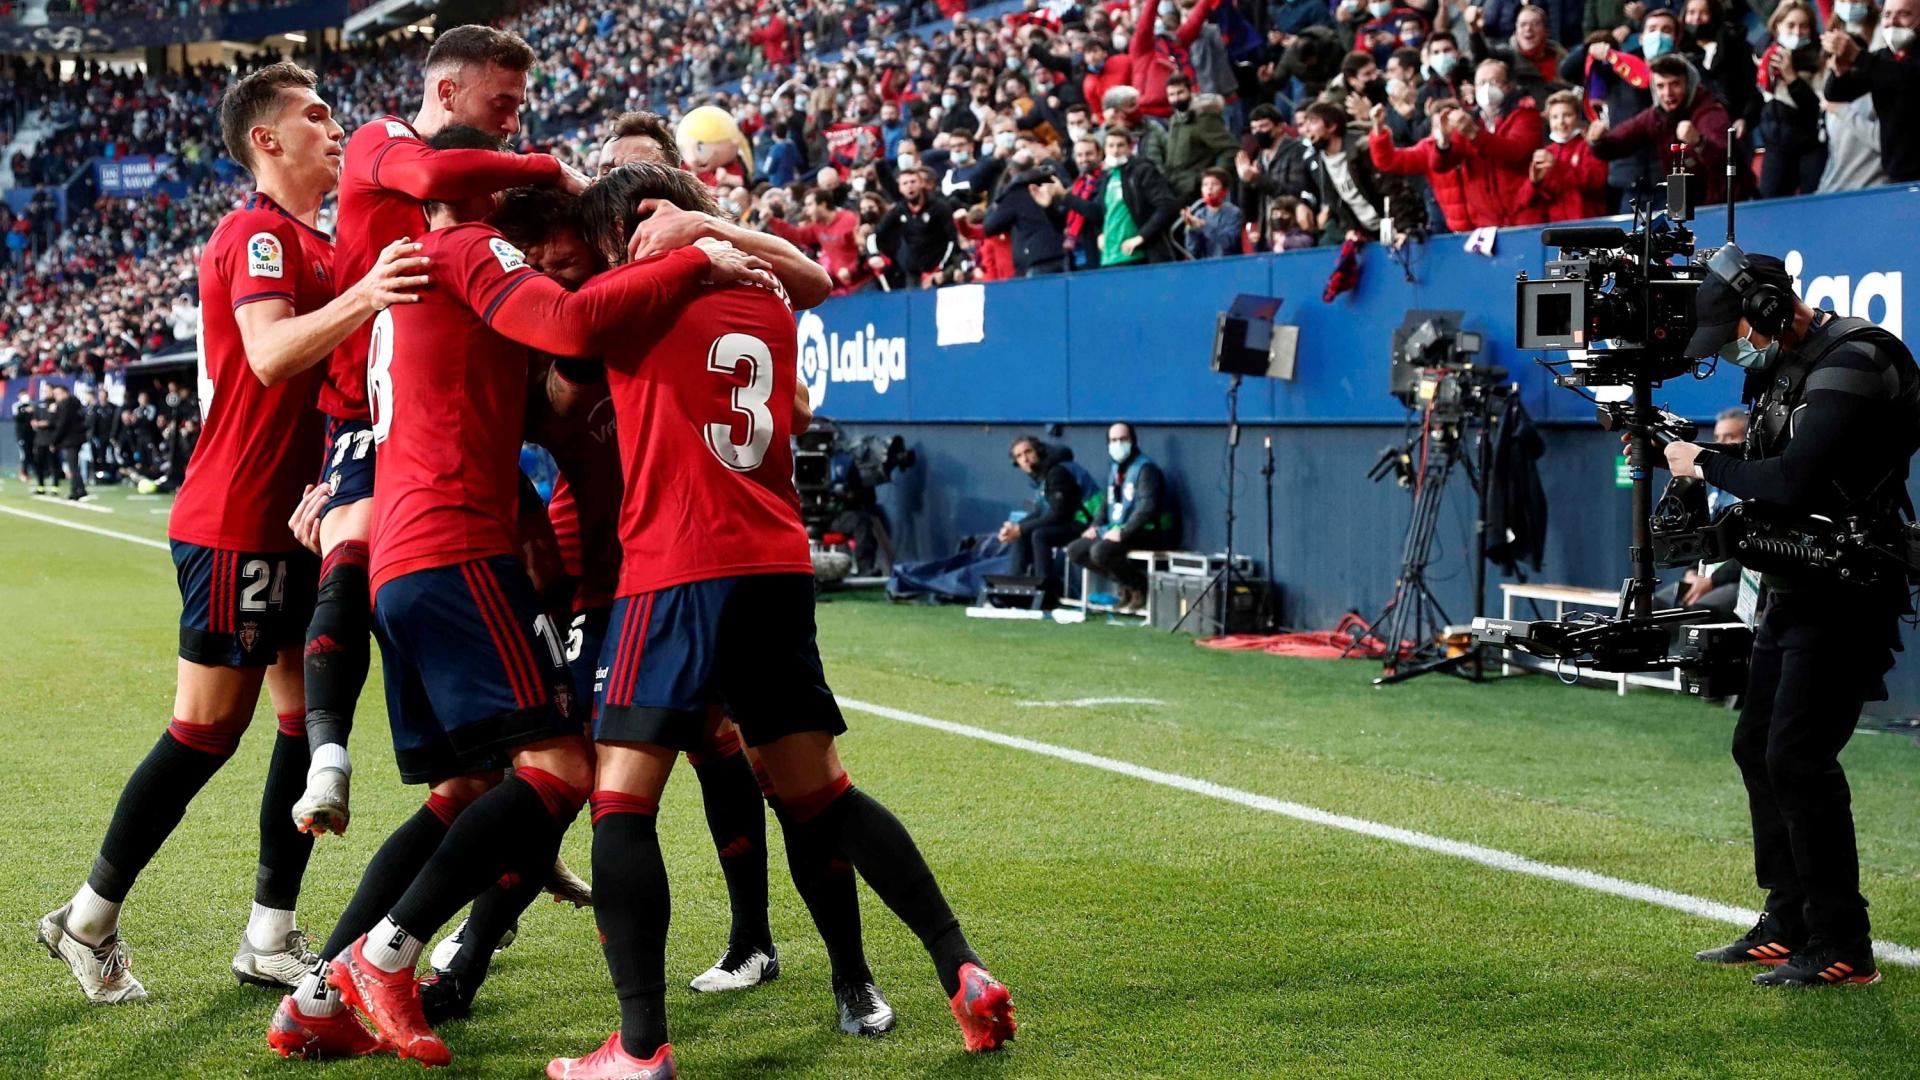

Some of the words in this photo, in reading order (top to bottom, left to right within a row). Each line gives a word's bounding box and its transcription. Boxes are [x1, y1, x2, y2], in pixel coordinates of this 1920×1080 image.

[252, 263, 280, 273] LaLiga
[505, 258, 522, 269] LaL
[1762, 300, 1779, 317] RTS
[830, 323, 906, 394] LaLiga
[703, 332, 774, 472] 3
[332, 429, 374, 468] 77
[239, 559, 287, 613] 24
[532, 613, 570, 668] 1
[348, 959, 374, 1014] ULTRA
